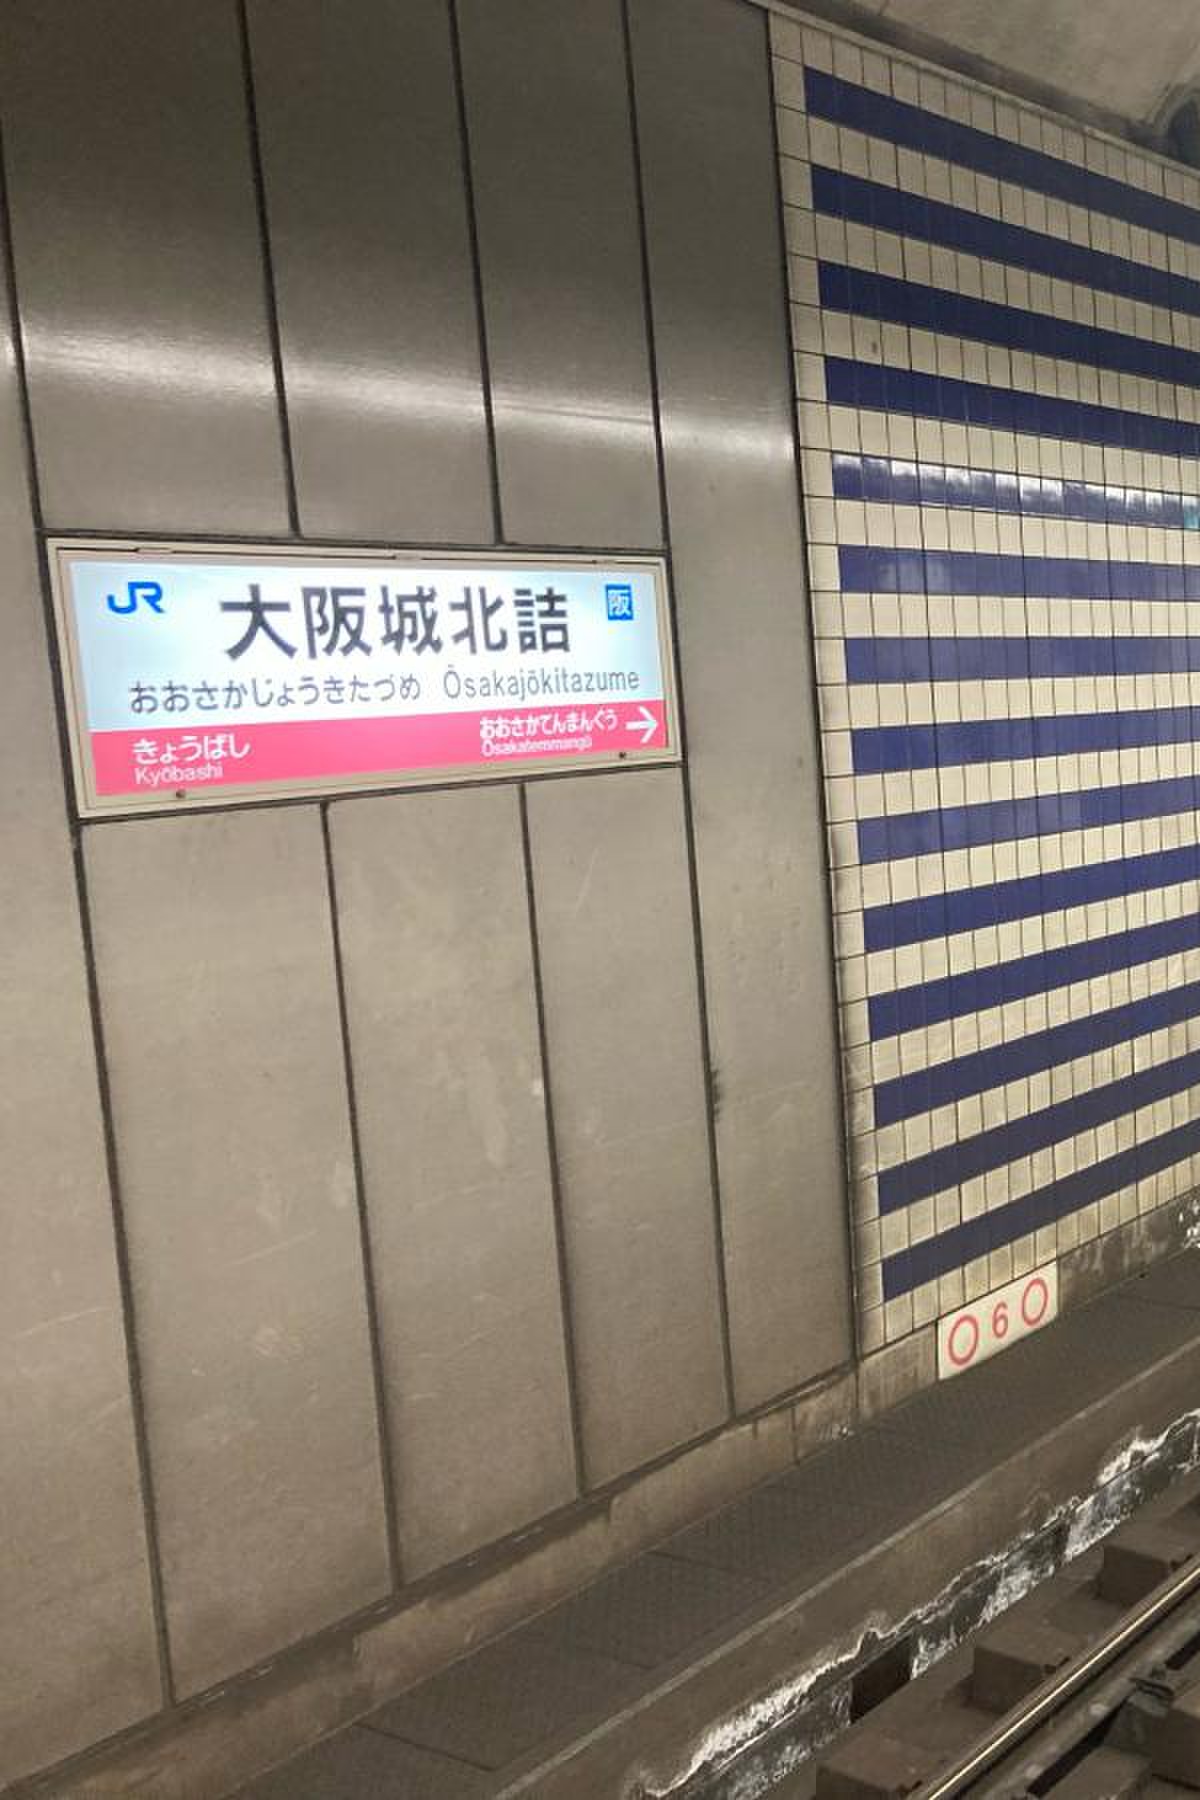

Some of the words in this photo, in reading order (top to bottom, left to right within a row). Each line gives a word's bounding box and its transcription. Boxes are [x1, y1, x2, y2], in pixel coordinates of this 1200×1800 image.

[107, 581, 166, 614] JR
[607, 587, 632, 617] 阪
[219, 583, 570, 660] 大阪城北詰
[130, 674, 421, 714] おおさかじょうきたづめ
[480, 708, 618, 739] おおさかてんまんぐう
[132, 732, 250, 765] きょうばし
[948, 1277, 1048, 1366] 060
